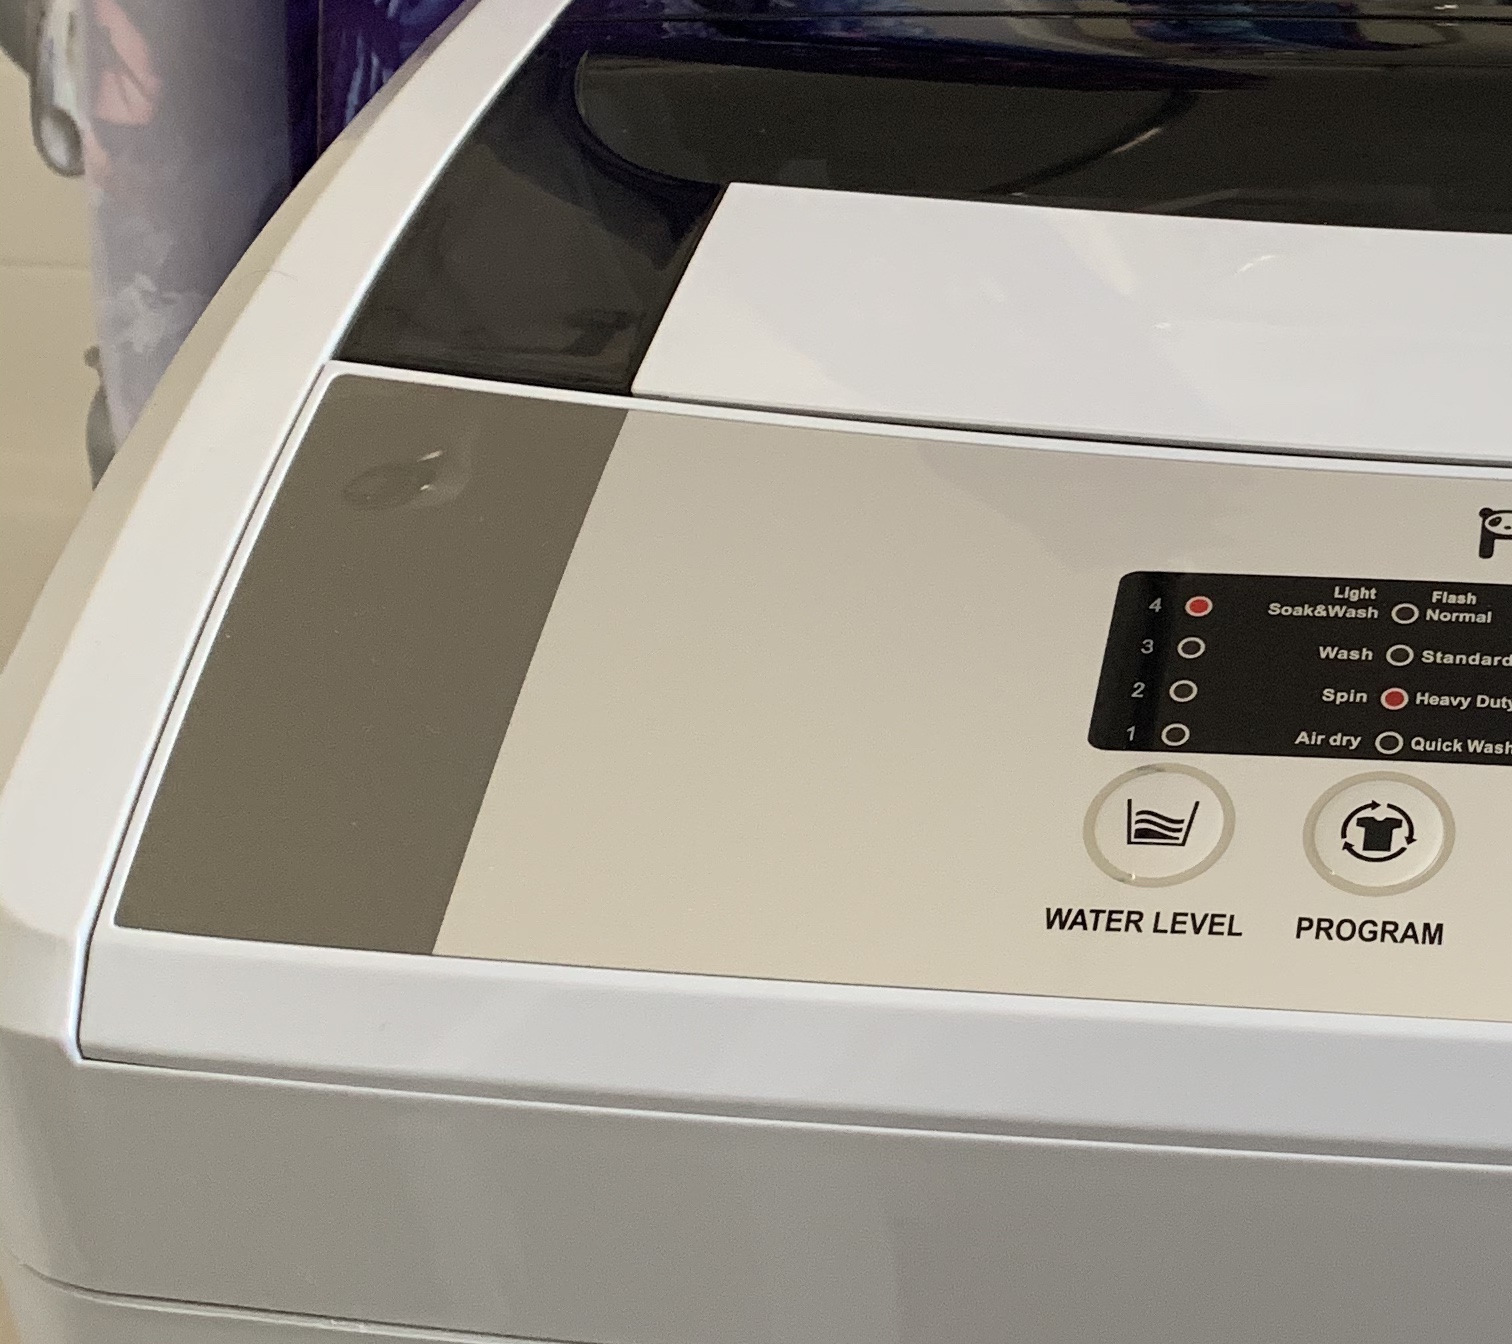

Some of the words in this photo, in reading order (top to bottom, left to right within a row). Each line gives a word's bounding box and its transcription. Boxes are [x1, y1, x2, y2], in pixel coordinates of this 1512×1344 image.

[1333, 585, 1377, 602] Light
[1431, 590, 1477, 605] Flash
[1148, 597, 1162, 613] 4
[1267, 602, 1379, 619] Soak&Wash
[1425, 608, 1493, 624] Normal
[1140, 638, 1154, 654] 3
[1319, 646, 1373, 661] Wash
[1131, 681, 1146, 698] 2
[1321, 688, 1368, 705] Spin
[1415, 691, 1472, 710] Heavy
[1126, 725, 1136, 742] 1
[1294, 731, 1326, 745] Air
[1328, 732, 1362, 750] dry
[1410, 736, 1463, 753] Quick
[1045, 907, 1144, 933] WATER
[1152, 911, 1243, 937] LEVEL
[1295, 916, 1444, 946] PROGRAM
